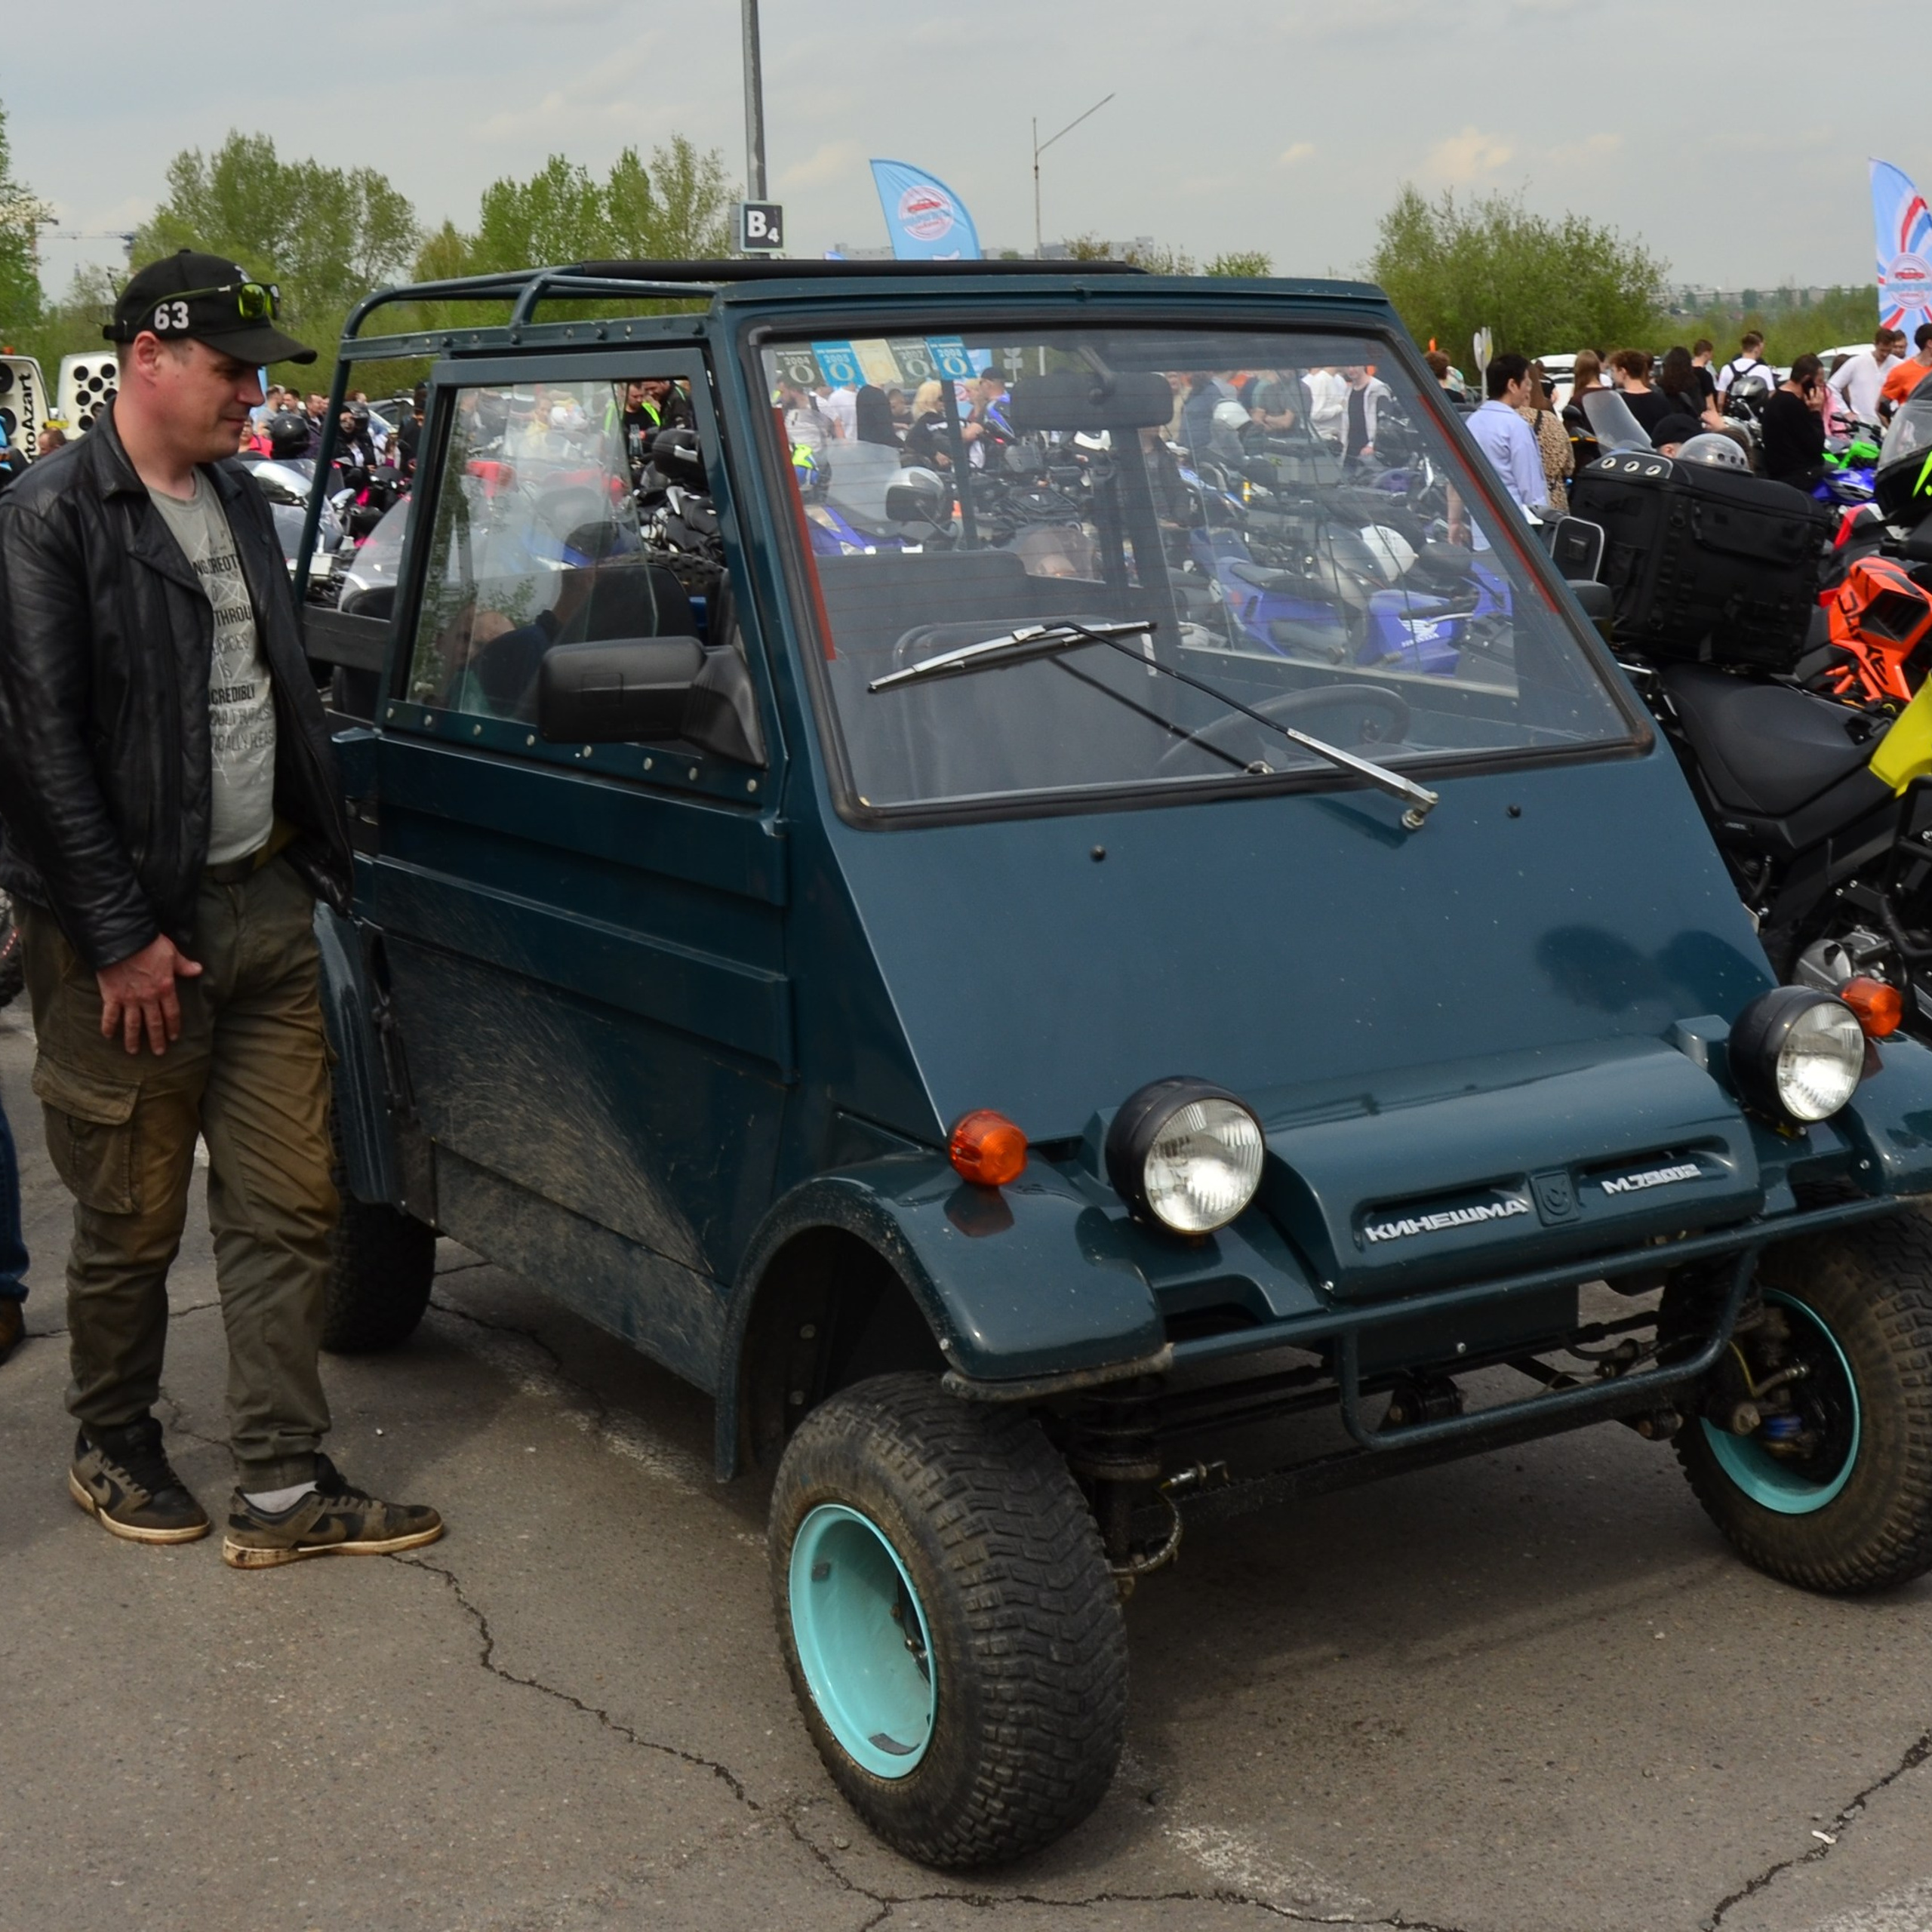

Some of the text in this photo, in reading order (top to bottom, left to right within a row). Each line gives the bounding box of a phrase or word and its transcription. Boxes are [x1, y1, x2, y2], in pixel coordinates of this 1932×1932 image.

[747, 211, 780, 242] B4
[154, 301, 189, 330] 63
[1364, 1199, 1529, 1242] КИНЕШМА
